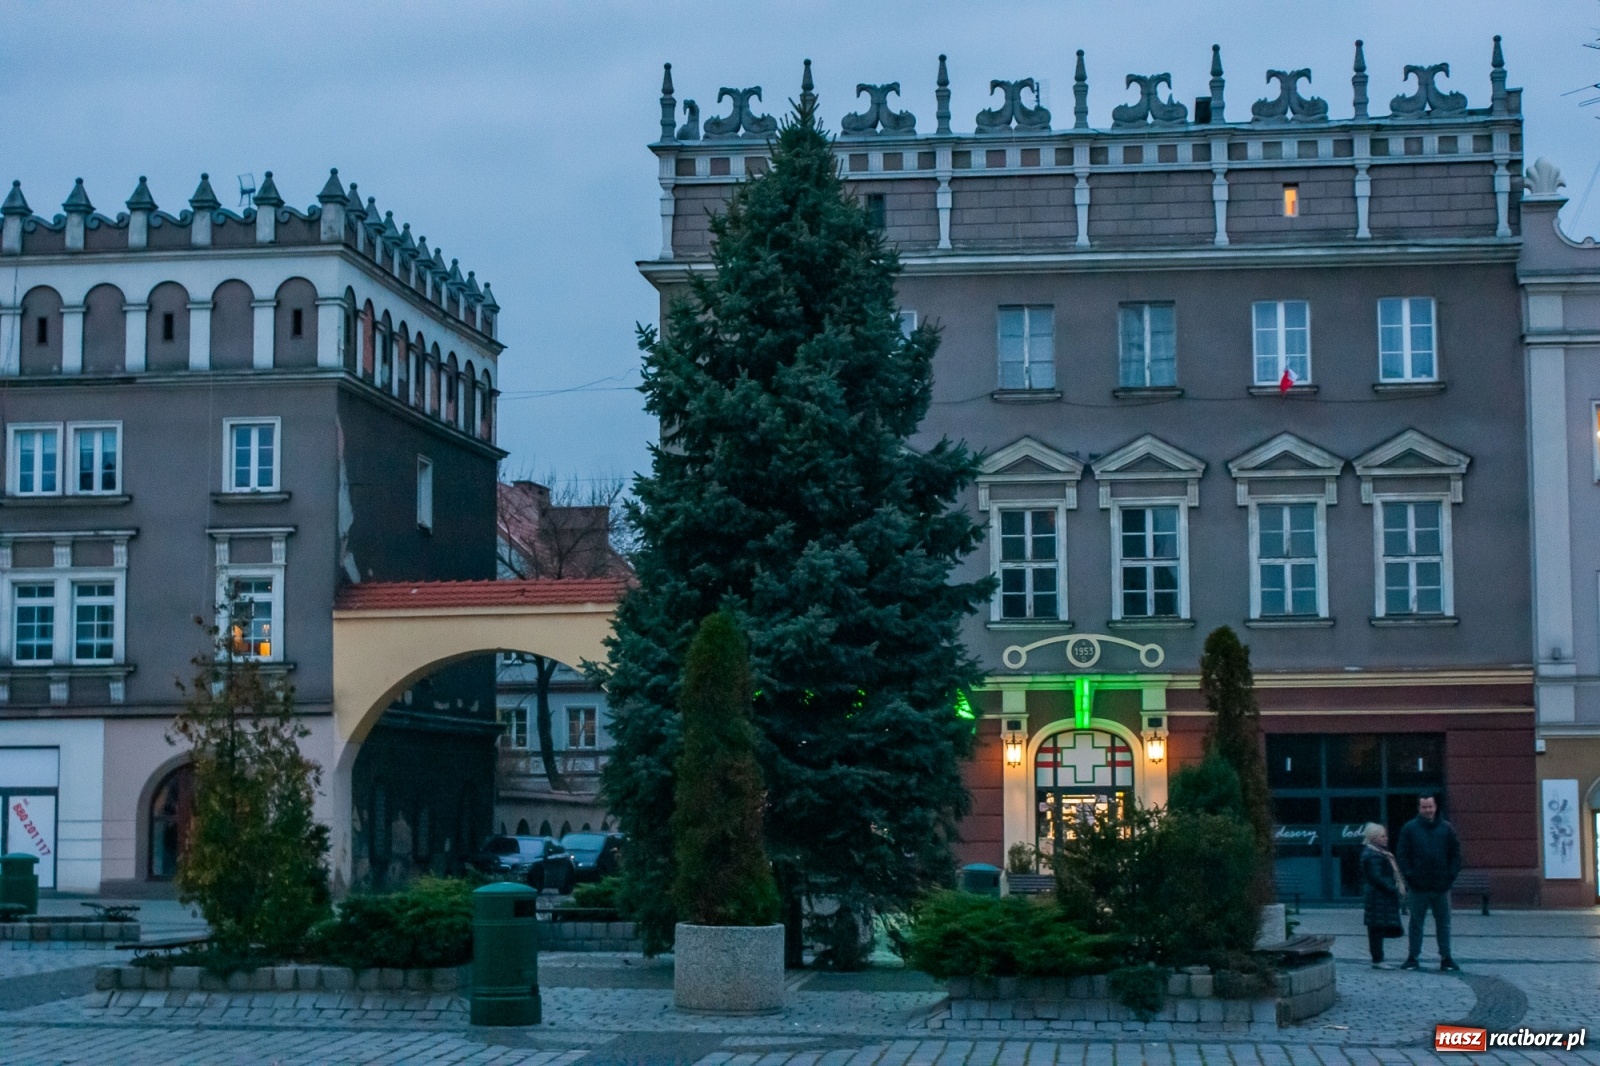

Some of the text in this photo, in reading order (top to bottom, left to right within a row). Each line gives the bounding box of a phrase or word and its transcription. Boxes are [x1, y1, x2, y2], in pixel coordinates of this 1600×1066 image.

[1074, 647, 1094, 656] 1953
[23, 820, 40, 839] 201
[35, 838, 52, 856] 117
[1342, 825, 1365, 838] lod
